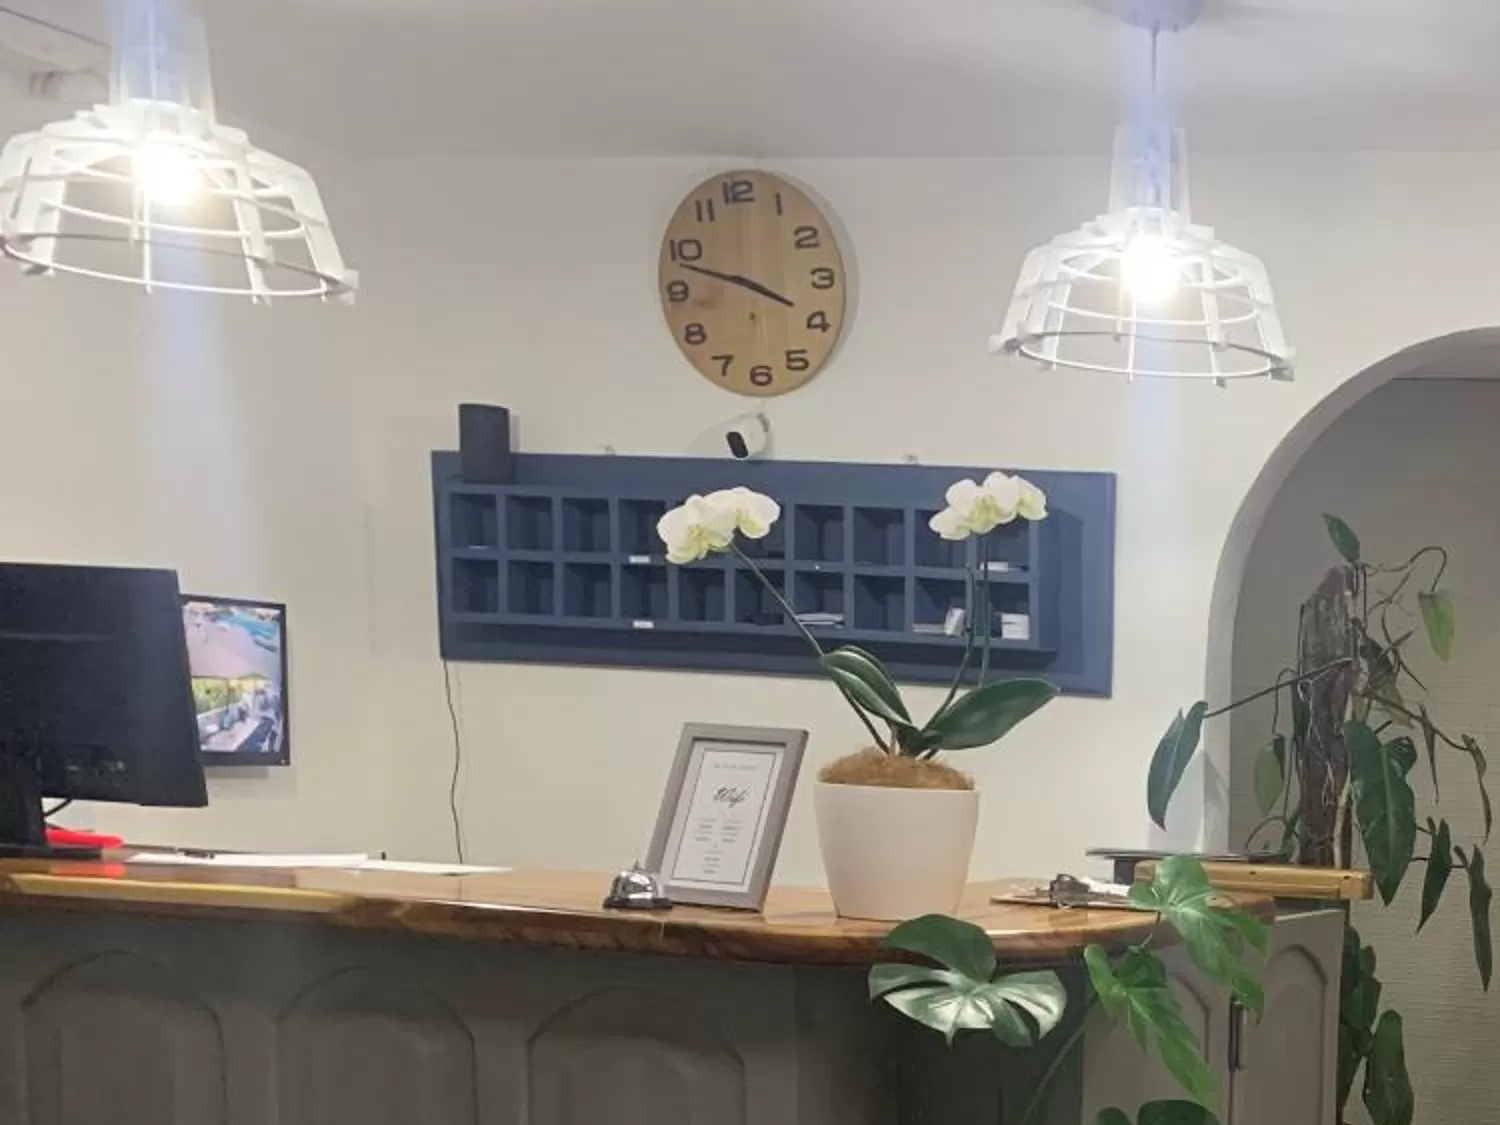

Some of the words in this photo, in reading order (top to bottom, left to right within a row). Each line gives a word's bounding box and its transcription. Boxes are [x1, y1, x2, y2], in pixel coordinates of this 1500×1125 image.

[722, 180, 755, 205] 12
[774, 192, 783, 216] 1
[695, 198, 715, 222] 11
[794, 226, 820, 249] 2
[669, 239, 703, 261] 10
[810, 267, 835, 289] 3
[667, 280, 689, 303] 9
[806, 310, 830, 333] 4
[684, 323, 707, 345] 8
[712, 354, 734, 377] 7
[785, 349, 809, 371] 5
[749, 365, 773, 386] 6
